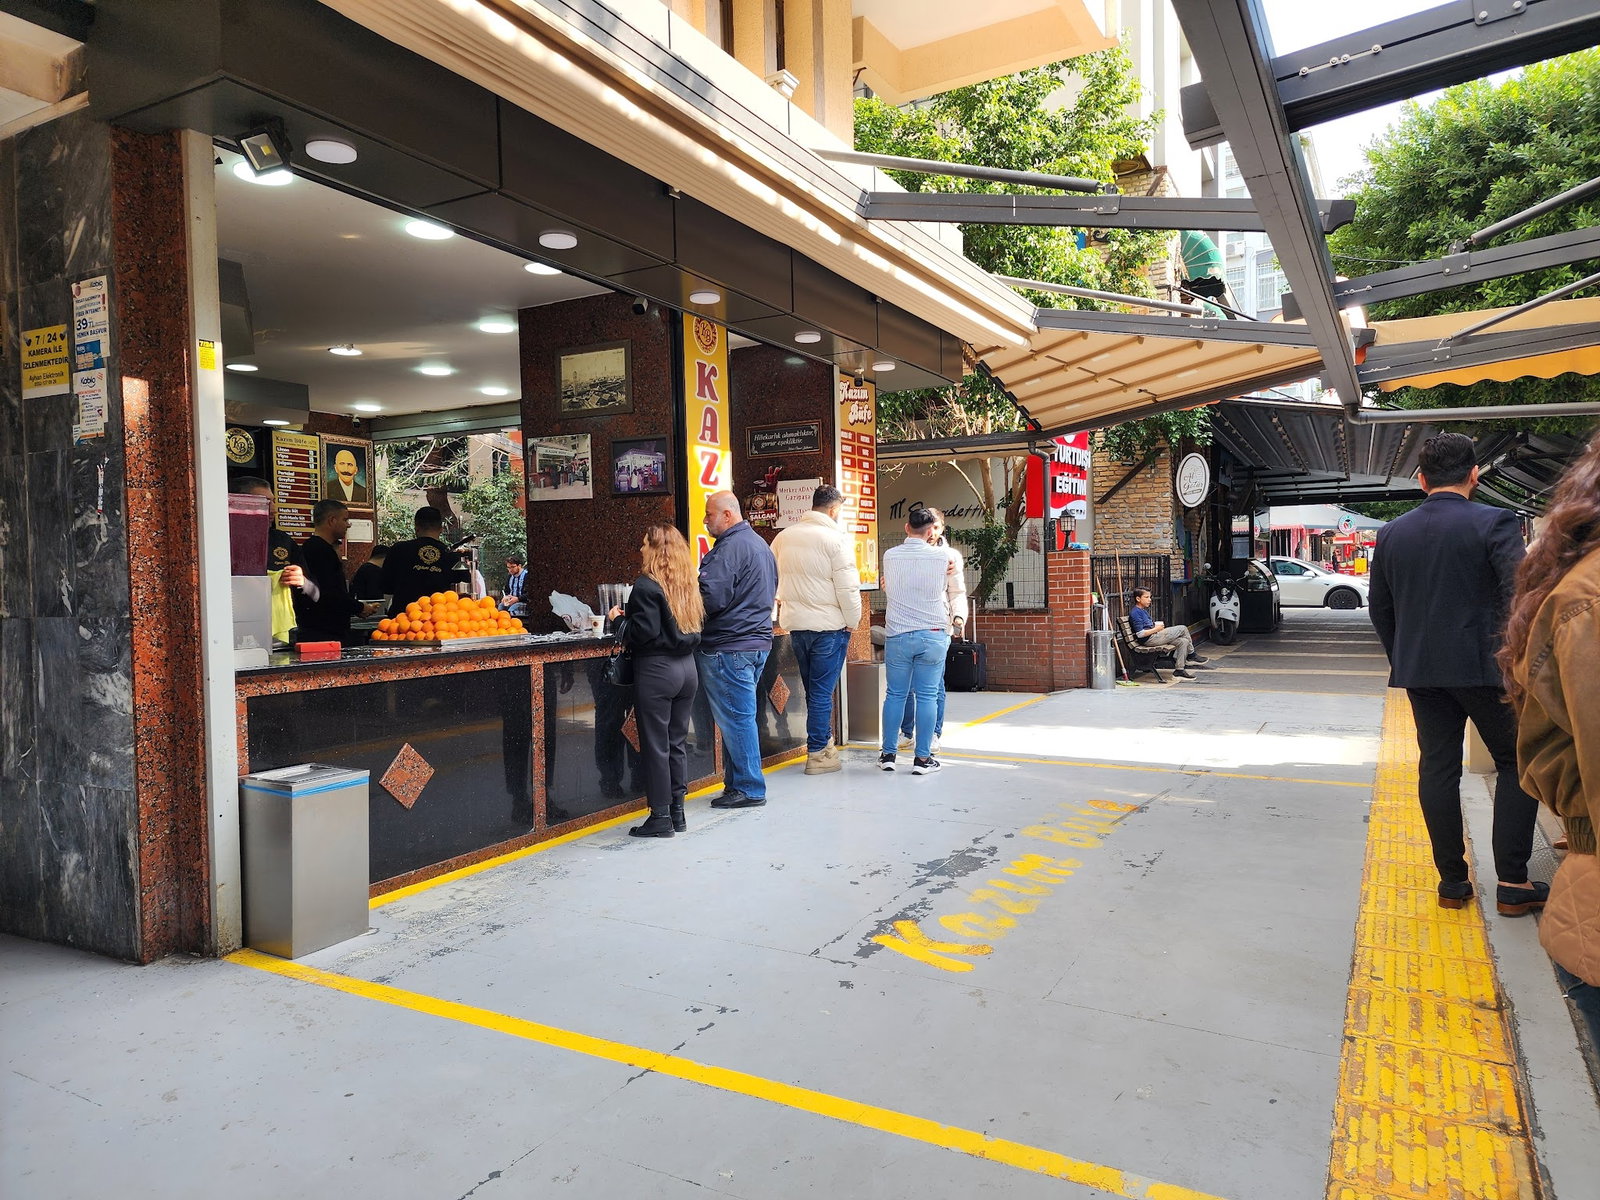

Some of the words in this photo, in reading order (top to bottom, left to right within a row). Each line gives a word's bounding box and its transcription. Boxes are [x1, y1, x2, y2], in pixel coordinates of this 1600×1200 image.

[76, 318, 88, 331] 39
[35, 335, 40, 345] 7
[47, 332, 58, 344] 24
[28, 347, 53, 358] KAMERA
[849, 401, 872, 424] Büfe
